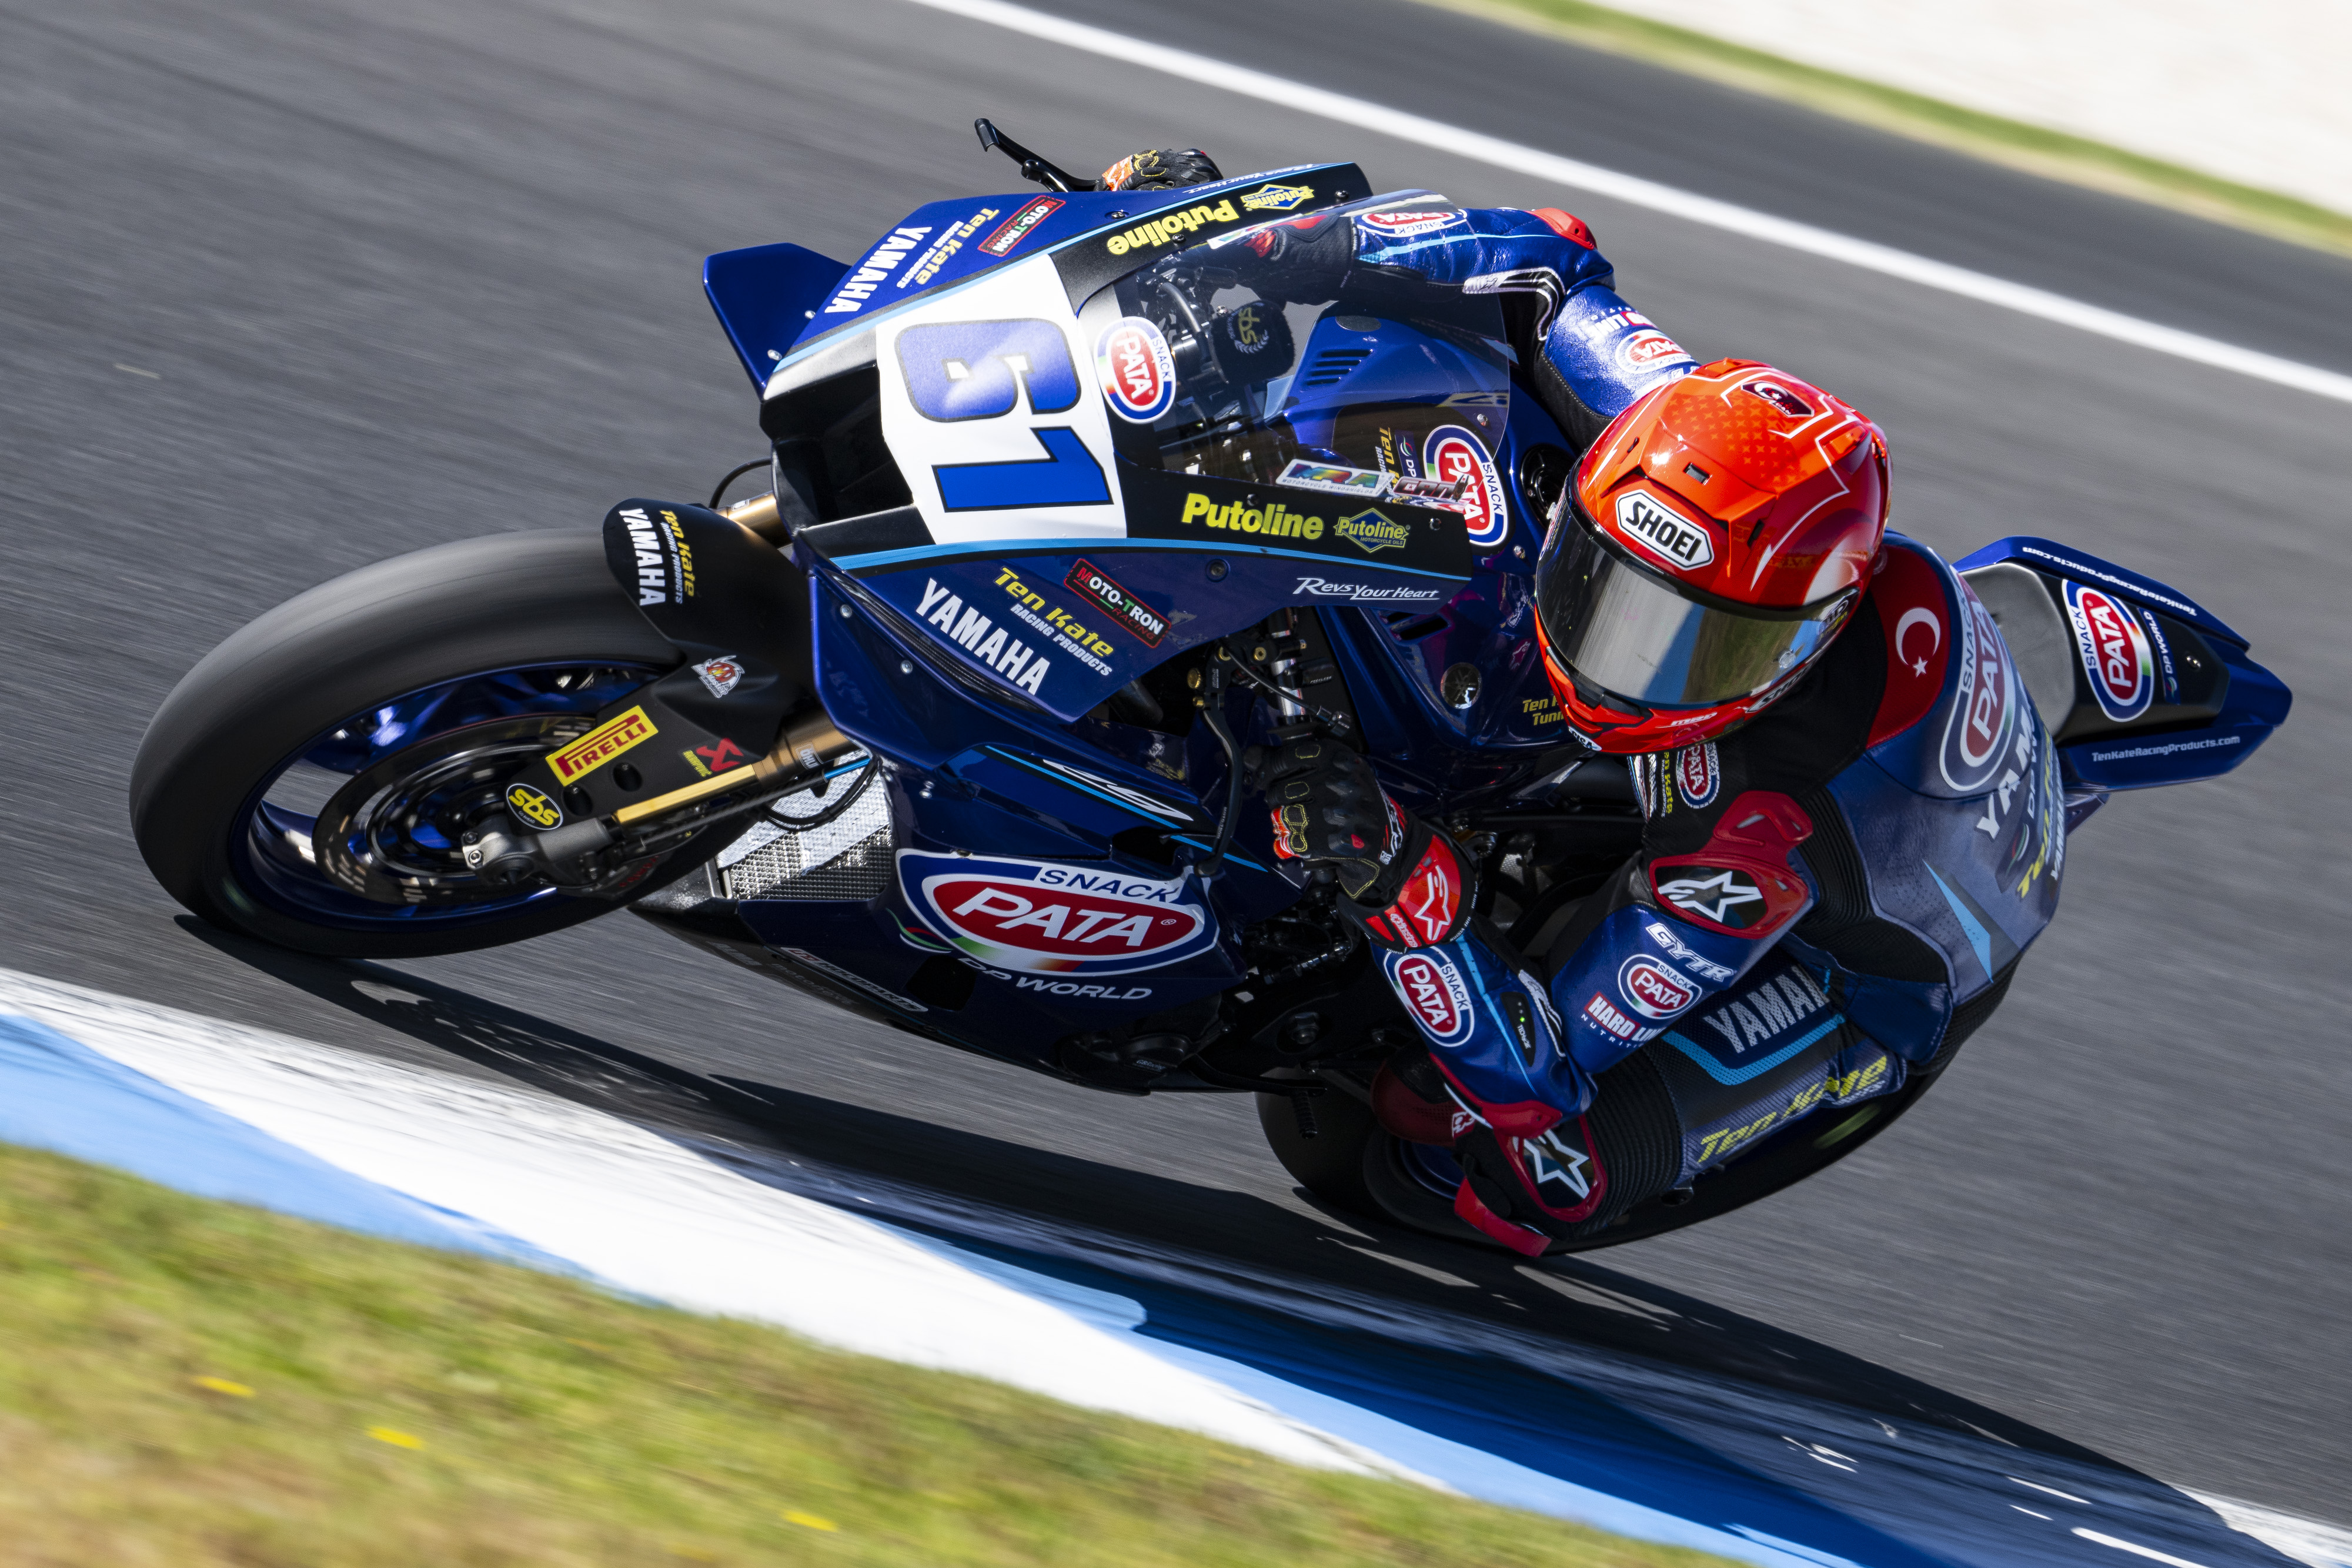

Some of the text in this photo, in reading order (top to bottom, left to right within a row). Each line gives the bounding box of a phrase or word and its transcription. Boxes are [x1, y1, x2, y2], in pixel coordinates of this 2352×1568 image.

[1248, 185, 1312, 209] Putoline
[915, 208, 1000, 285] Ten Kate
[987, 219, 1018, 248] RACING
[993, 199, 1058, 252] MOTO-TRON
[1107, 199, 1240, 255] Putoline
[1398, 222, 1442, 235] SNACK
[824, 226, 933, 313] YAMAHA
[1117, 329, 1152, 400] PATA
[1151, 337, 1172, 380] SNACK
[894, 317, 1114, 513] 61
[1379, 426, 1395, 465] Ten
[1405, 459, 1417, 477] DP
[1282, 479, 1374, 495] MOTORCYCLE WINDSHIELDS
[1286, 463, 1380, 489] MRA
[1445, 452, 1484, 528] PATA
[1482, 463, 1505, 515] SNACK
[1181, 492, 1325, 540] Putoline
[1337, 520, 1406, 540] Putoline
[1360, 536, 1391, 544] MOTORCYCLE
[1626, 501, 1701, 561] SHOEI
[619, 508, 666, 607] YAMAHA
[660, 509, 696, 597] Ten Kate
[660, 521, 683, 604] RACING PRODUCTS
[1077, 567, 1164, 636] MOTO-TRON
[2023, 546, 2198, 617] TenKateRacingProducts.com
[916, 577, 1051, 696] YAMAHA
[994, 567, 1115, 659] Ten Kate
[1111, 607, 1156, 641] RACING
[2074, 608, 2096, 668] SNACK
[1010, 604, 1113, 677] RACING PRODUCTS
[2098, 604, 2133, 688] PATA
[2143, 611, 2174, 674] DP WORLD
[1972, 601, 2000, 742] PATA
[1522, 698, 1549, 713] Ten
[1532, 711, 1565, 726] Tuni
[553, 713, 648, 779] PIRELLI
[1687, 744, 1706, 792] PATA
[2092, 735, 2241, 763] TenKateRacingProducts.com
[508, 788, 560, 826] sbs
[1040, 868, 1179, 904] SNACK
[952, 886, 1154, 947] PATA
[957, 957, 1152, 999] DP WORLD
[1645, 922, 1736, 983] GYTR
[1656, 964, 1691, 990] SNACK
[1403, 964, 1445, 1027] PATA
[1441, 964, 1468, 1009] SNACK
[1634, 969, 1684, 1009] PATA
[1702, 964, 1830, 1054] YAMA
[1581, 1013, 1646, 1048] NUTRITI
[1588, 995, 1636, 1038] HARD
[1697, 1112, 1778, 1164] Ten
